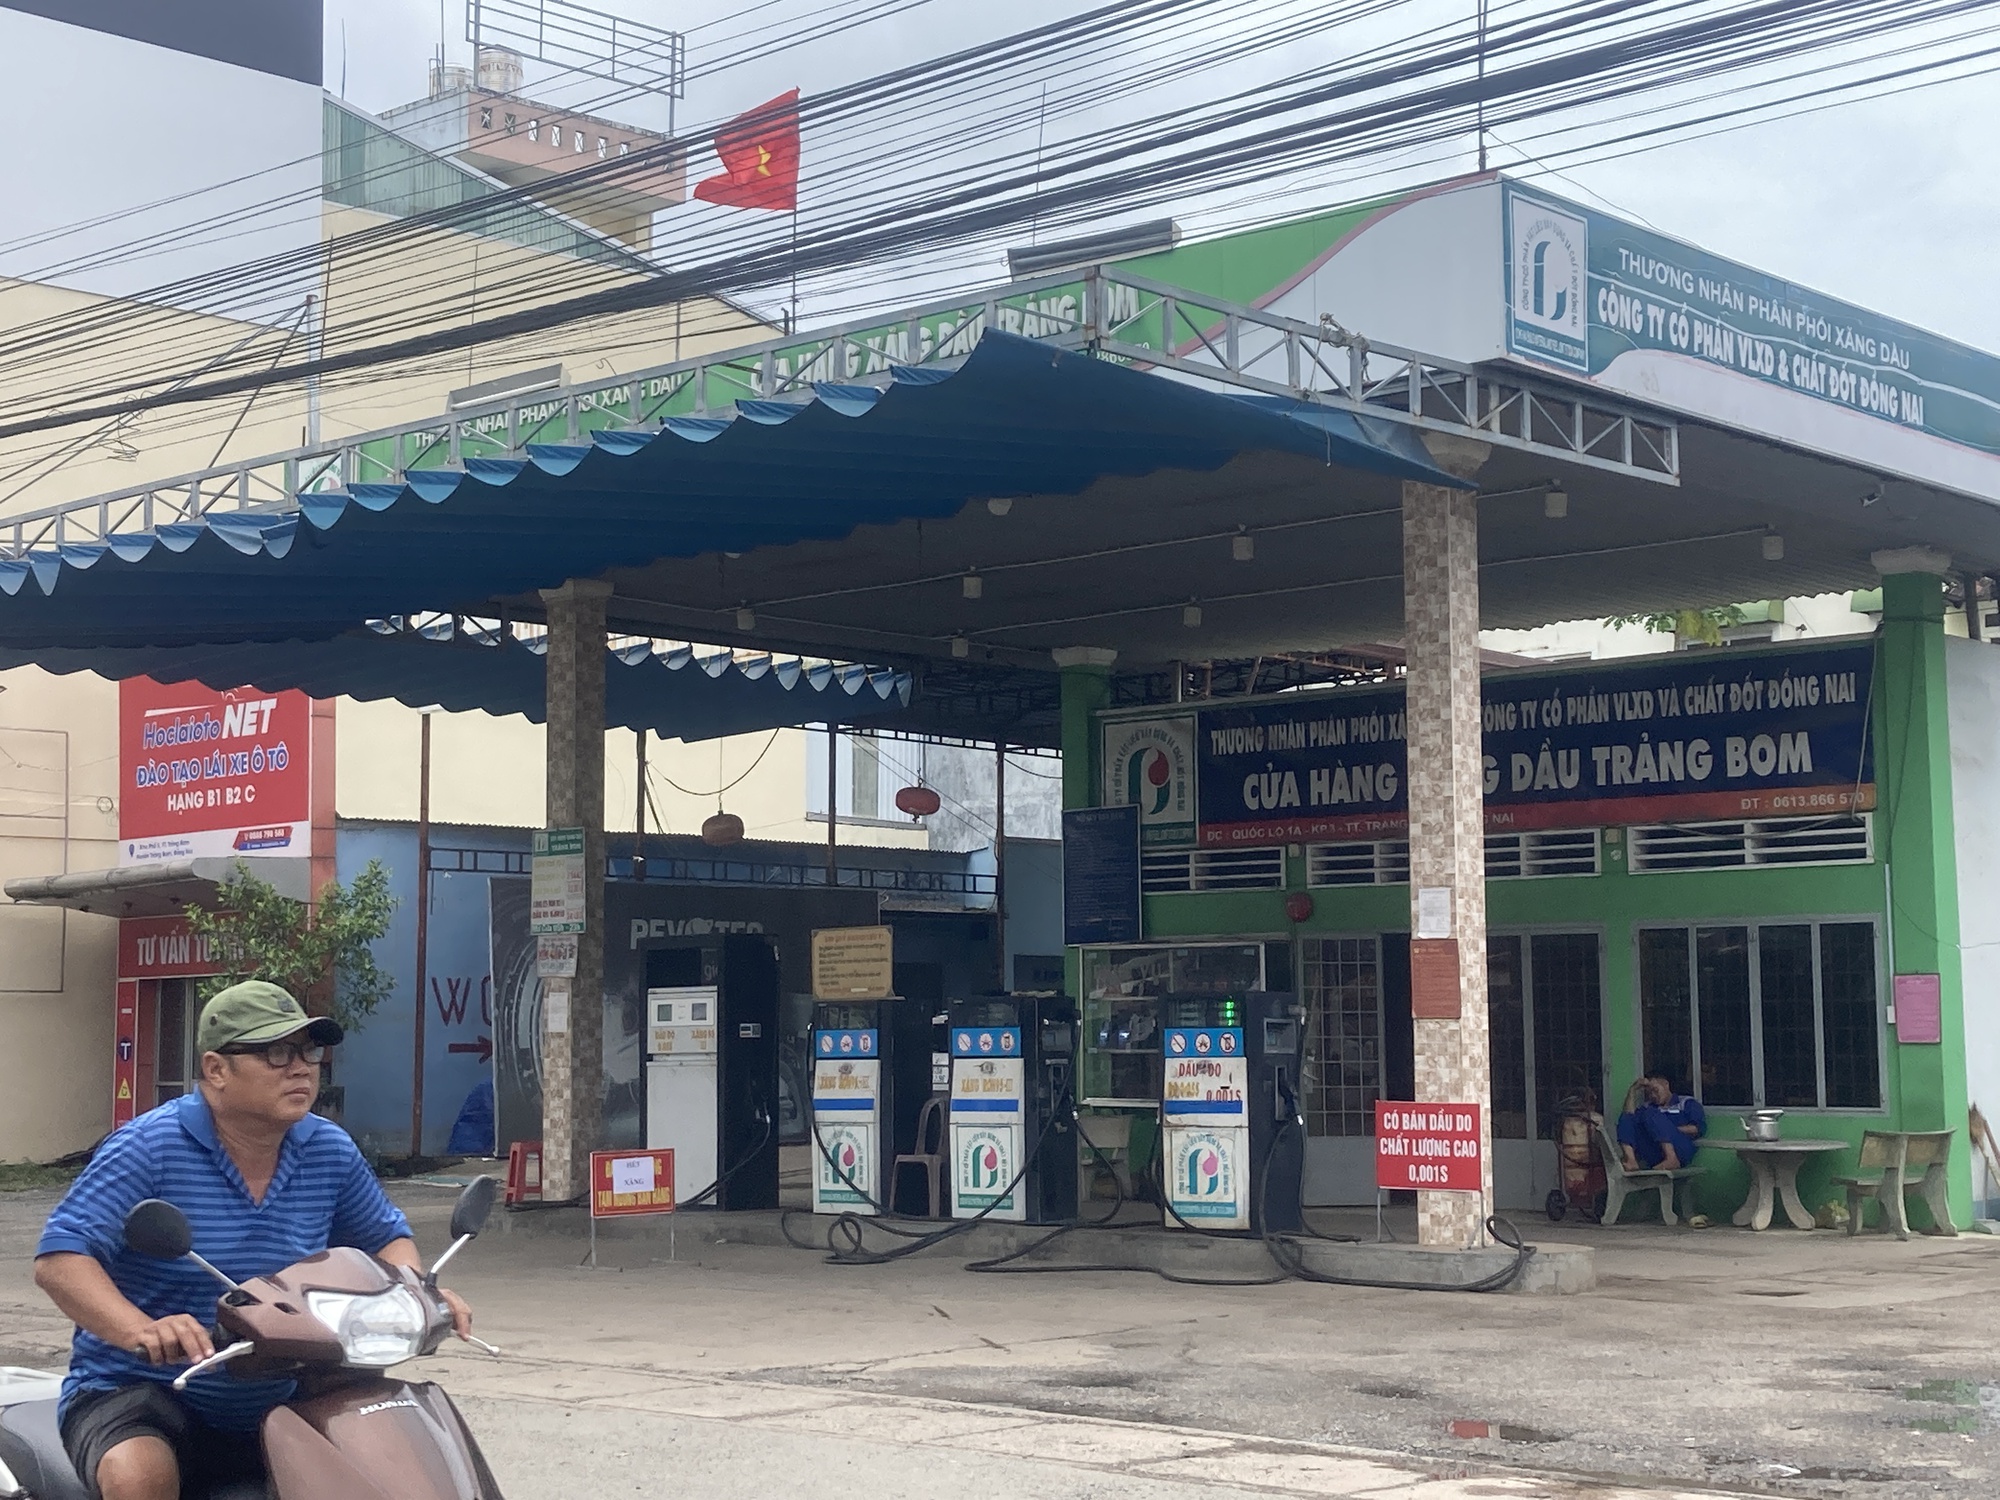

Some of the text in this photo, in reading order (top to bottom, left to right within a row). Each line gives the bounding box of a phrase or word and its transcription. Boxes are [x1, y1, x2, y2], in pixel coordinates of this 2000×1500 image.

[1618, 247, 1910, 370] THƯƠNG NHÂN PHÂN PHỐI XĂNG DẦU
[1597, 283, 1644, 334] CÔNG
[1646, 302, 1666, 341] TY
[1737, 333, 1775, 377] VLXD
[1777, 348, 1790, 383] &
[1792, 348, 1827, 395] CHẤT
[1828, 360, 1858, 404] ĐỐT
[1859, 368, 1899, 418] ĐỒNG
[1901, 389, 1924, 426] NAI
[221, 698, 278, 740] NET
[1268, 717, 1306, 751] NHÂN
[1309, 713, 1347, 748] PHÂN
[1350, 706, 1385, 744] PHỐI
[1520, 700, 1538, 730] TY
[1612, 690, 1655, 721] VLXD
[1657, 680, 1681, 718] VÀ
[1684, 674, 1726, 716] CHẤT
[1729, 670, 1764, 712] ĐỐT
[1767, 667, 1820, 709] ĐỒNG
[1824, 672, 1856, 704] NAI
[136, 740, 289, 789] ĐÀO TẠO LÁI XE Ô TÔ
[1243, 761, 1301, 811] CỬA
[1309, 759, 1399, 806] HÀNG
[1510, 736, 1581, 792] DẦU
[1591, 731, 1714, 787] TRẢNG
[1725, 731, 1813, 778] BOM
[167, 784, 256, 816] HẠNG B1 B2 C
[137, 934, 157, 966] TƯ
[159, 924, 190, 965] VẤN
[1383, 1108, 1473, 1132] CÓ BÁN DẦU DO
[1379, 1131, 1478, 1161] CHẤT LƯỢNG CAO
[1408, 1163, 1449, 1184] 0,001S
[359, 1399, 419, 1416] HONDA
